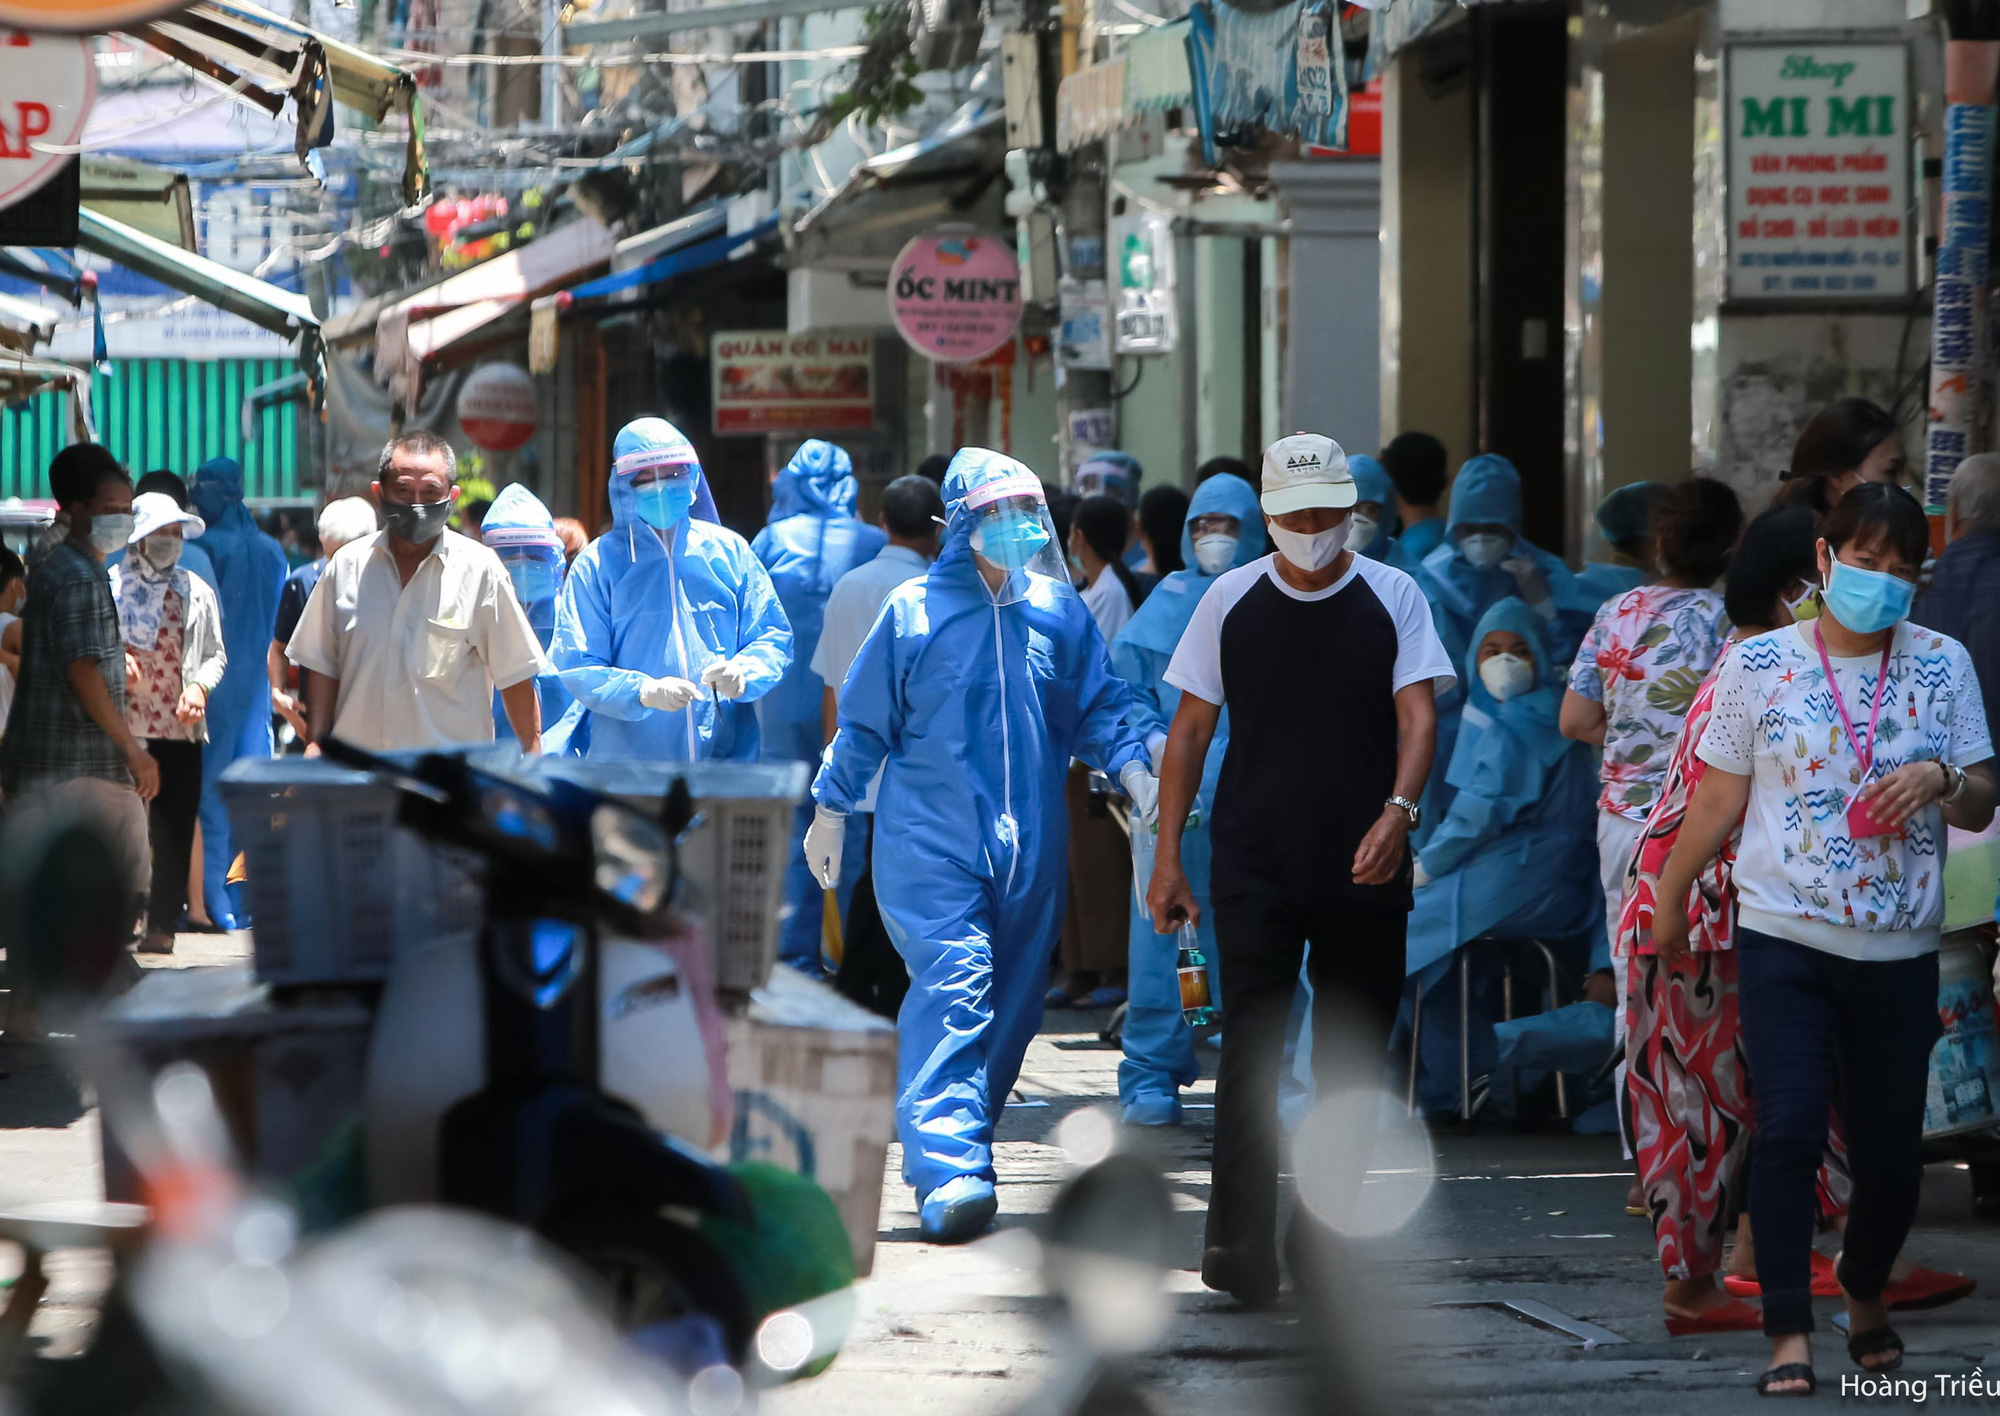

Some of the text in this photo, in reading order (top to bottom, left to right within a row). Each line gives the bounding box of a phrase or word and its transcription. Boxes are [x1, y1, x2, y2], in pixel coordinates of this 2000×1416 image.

[1780, 55, 1855, 88] Shop
[1741, 96, 1895, 137] MI MI
[896, 264, 1020, 303] ỐC MINT
